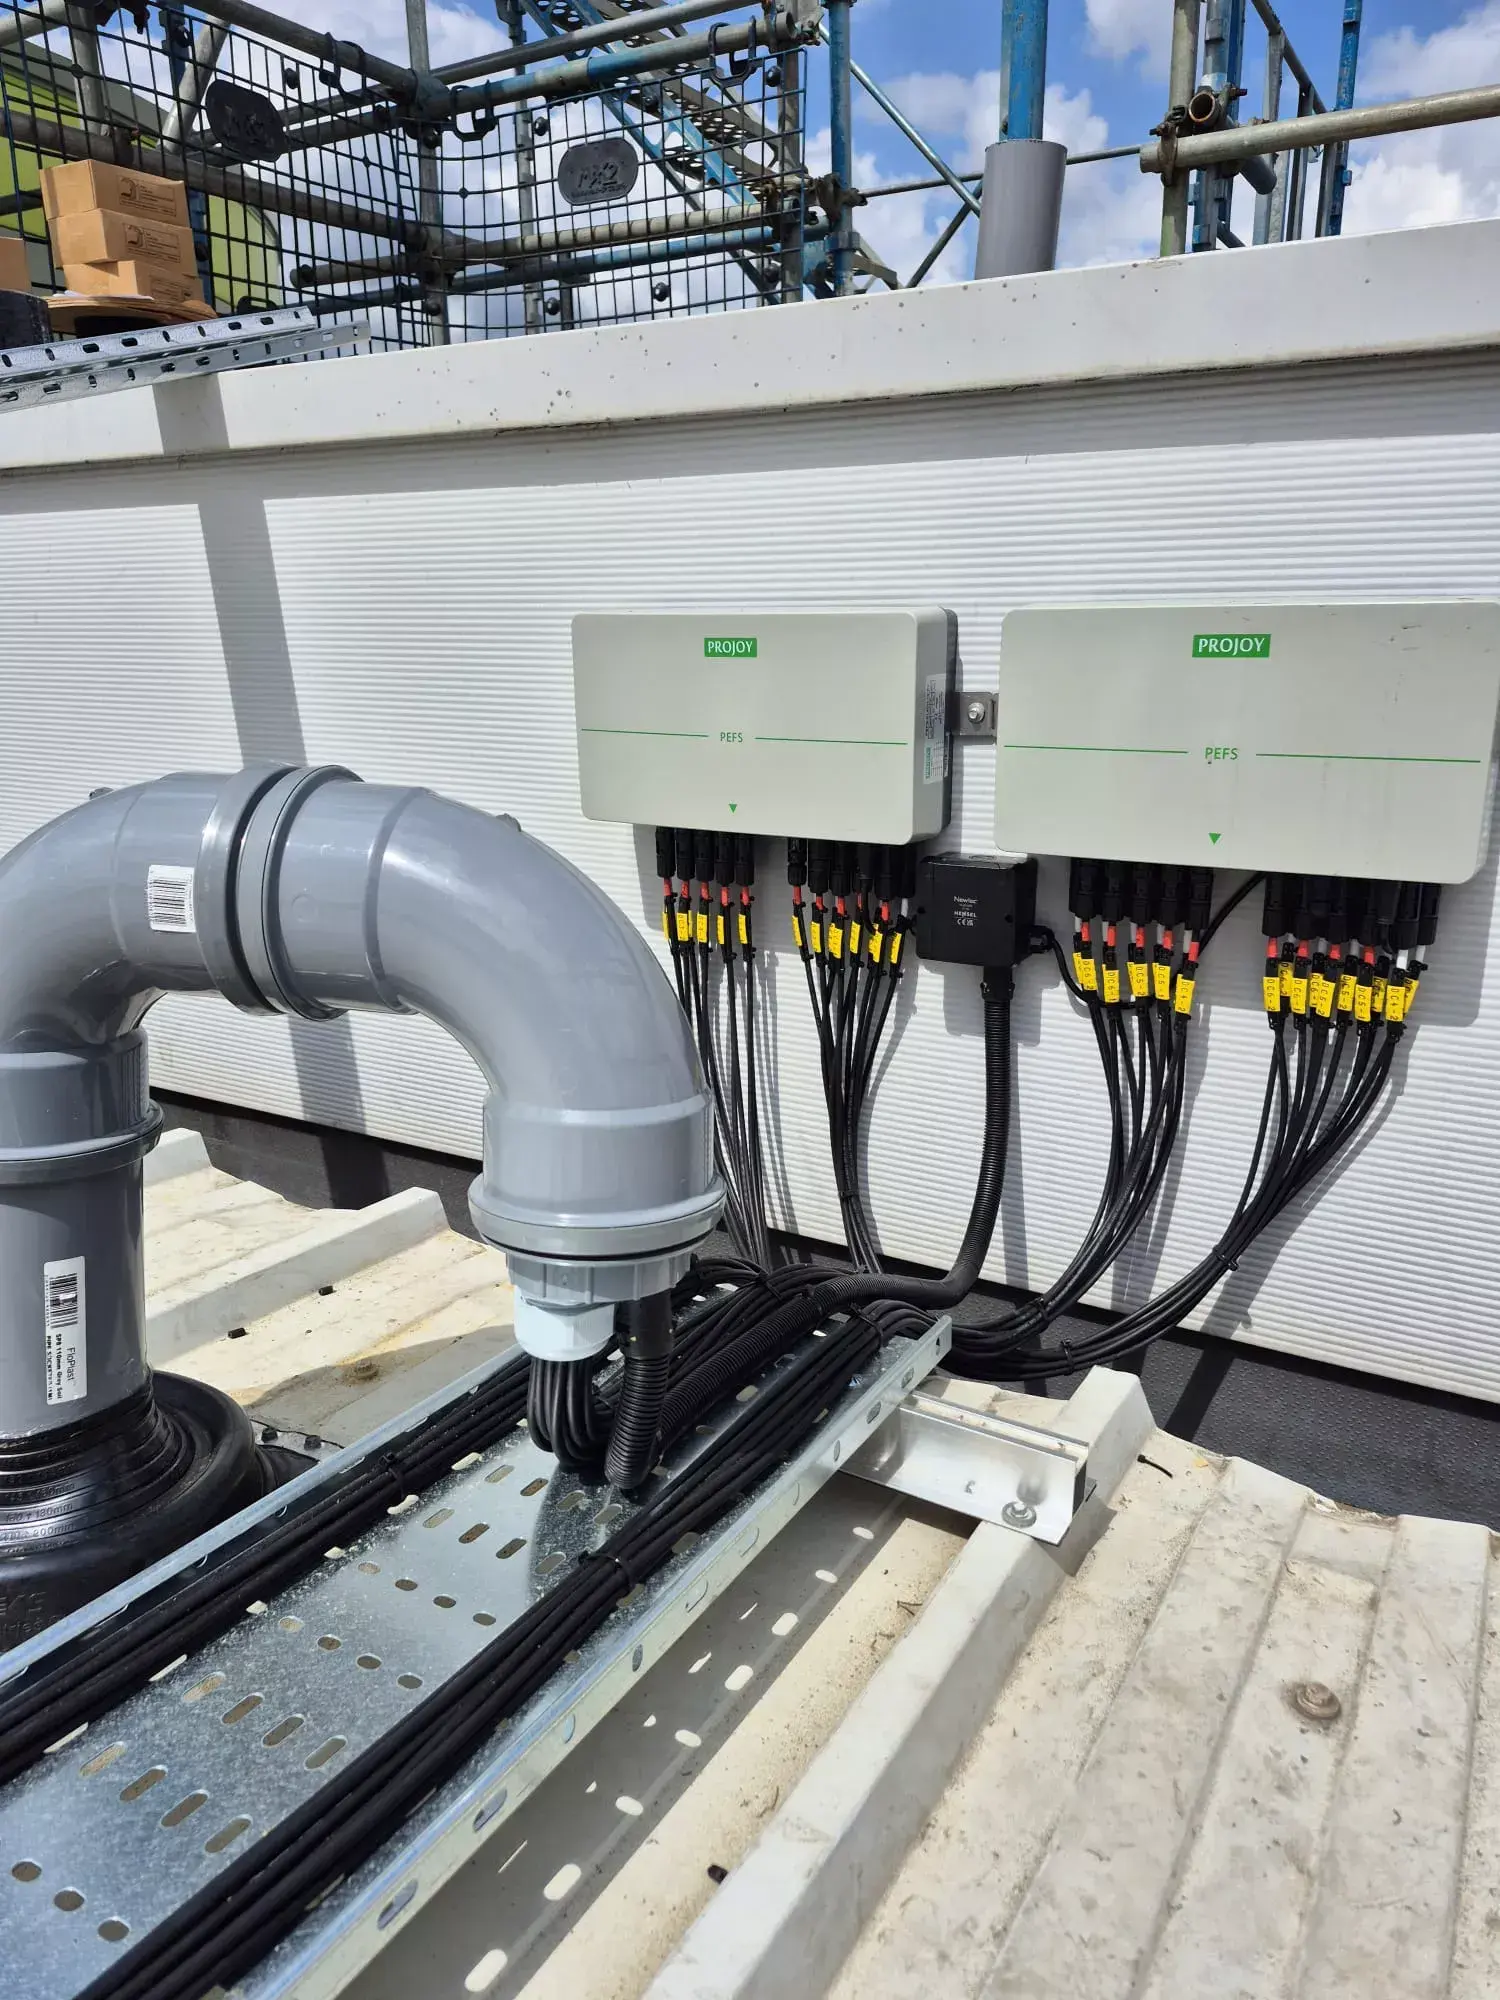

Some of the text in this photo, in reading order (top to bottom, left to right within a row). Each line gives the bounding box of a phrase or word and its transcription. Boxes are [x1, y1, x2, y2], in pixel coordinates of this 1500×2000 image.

[707, 640, 753, 656] PROJOY
[1198, 637, 1265, 656] PROJOY
[720, 731, 743, 743] PEFS
[1205, 746, 1239, 760] PEFS
[953, 910, 977, 918] HENSEL
[66, 1346, 77, 1382] FloPlast
